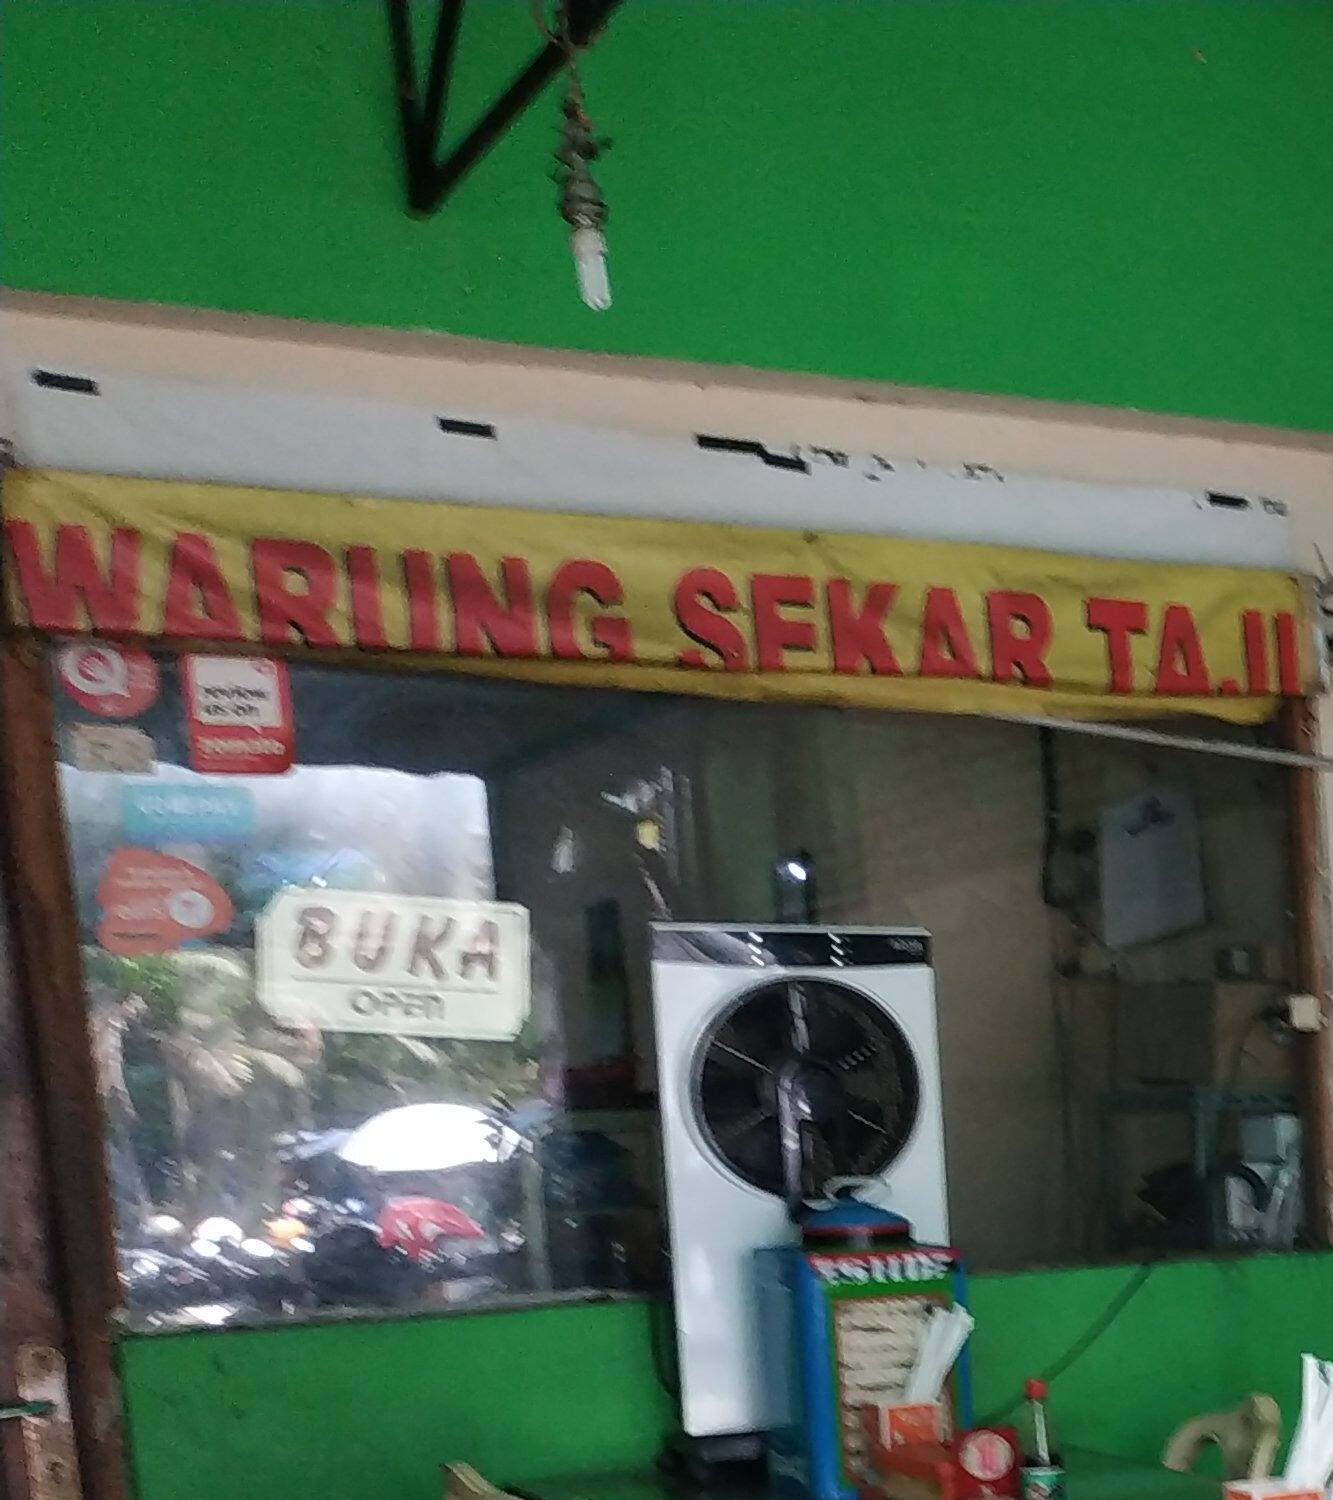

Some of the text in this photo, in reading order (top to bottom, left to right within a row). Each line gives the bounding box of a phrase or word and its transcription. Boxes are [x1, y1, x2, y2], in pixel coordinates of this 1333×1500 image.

[4, 518, 1302, 698] WARUNG SEKAR TAJI
[295, 905, 502, 982] BUKA
